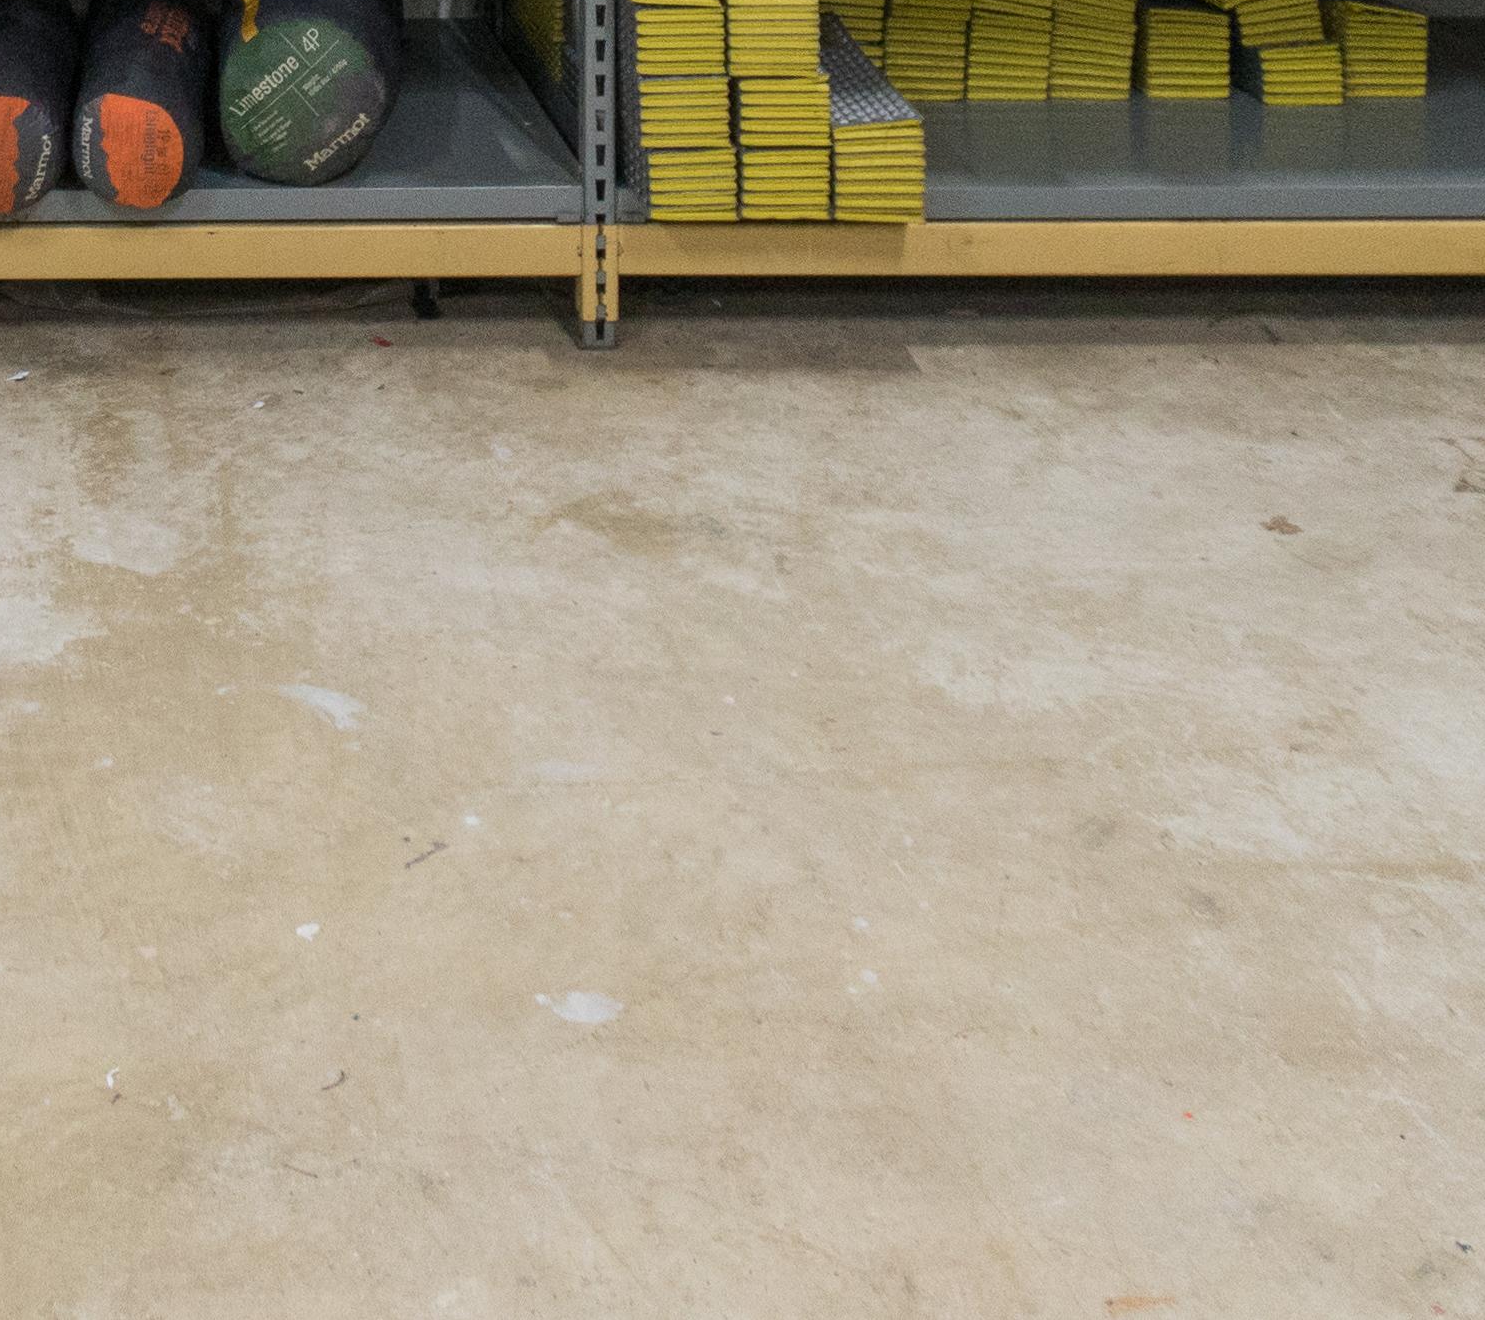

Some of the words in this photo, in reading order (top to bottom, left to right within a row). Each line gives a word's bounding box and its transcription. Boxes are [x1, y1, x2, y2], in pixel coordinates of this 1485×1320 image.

[228, 55, 300, 117] Limestone
[301, 27, 321, 53] 4P
[24, 133, 52, 202] Marmot
[80, 115, 94, 179] Marmot
[302, 112, 371, 172] Marmot
